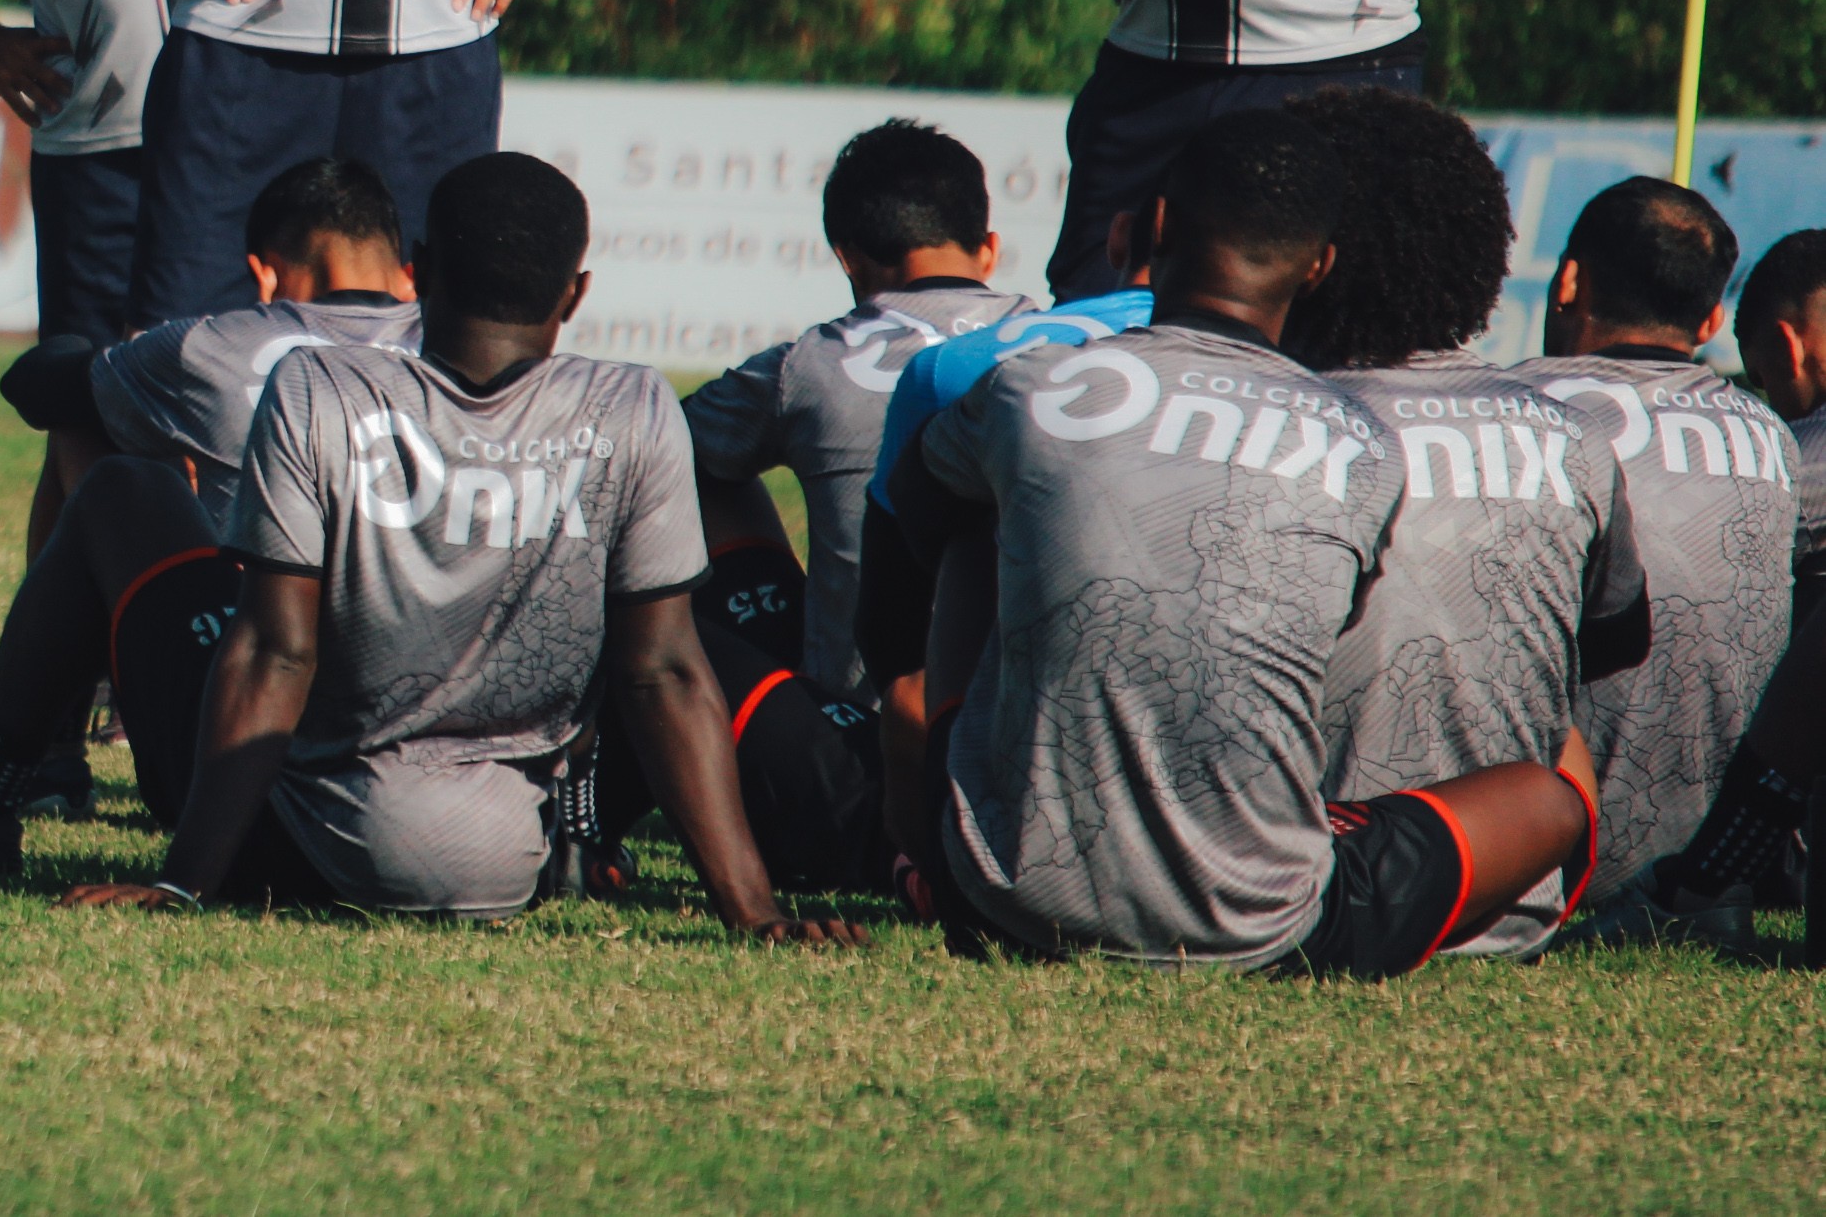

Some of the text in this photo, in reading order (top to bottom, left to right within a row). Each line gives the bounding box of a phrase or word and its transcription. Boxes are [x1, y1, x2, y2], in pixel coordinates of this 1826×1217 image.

[1181, 371, 1371, 441] COLCHÃO
[1394, 393, 1563, 427] COLCHÃO
[459, 425, 595, 463] COLCHO
[727, 584, 788, 625] 25
